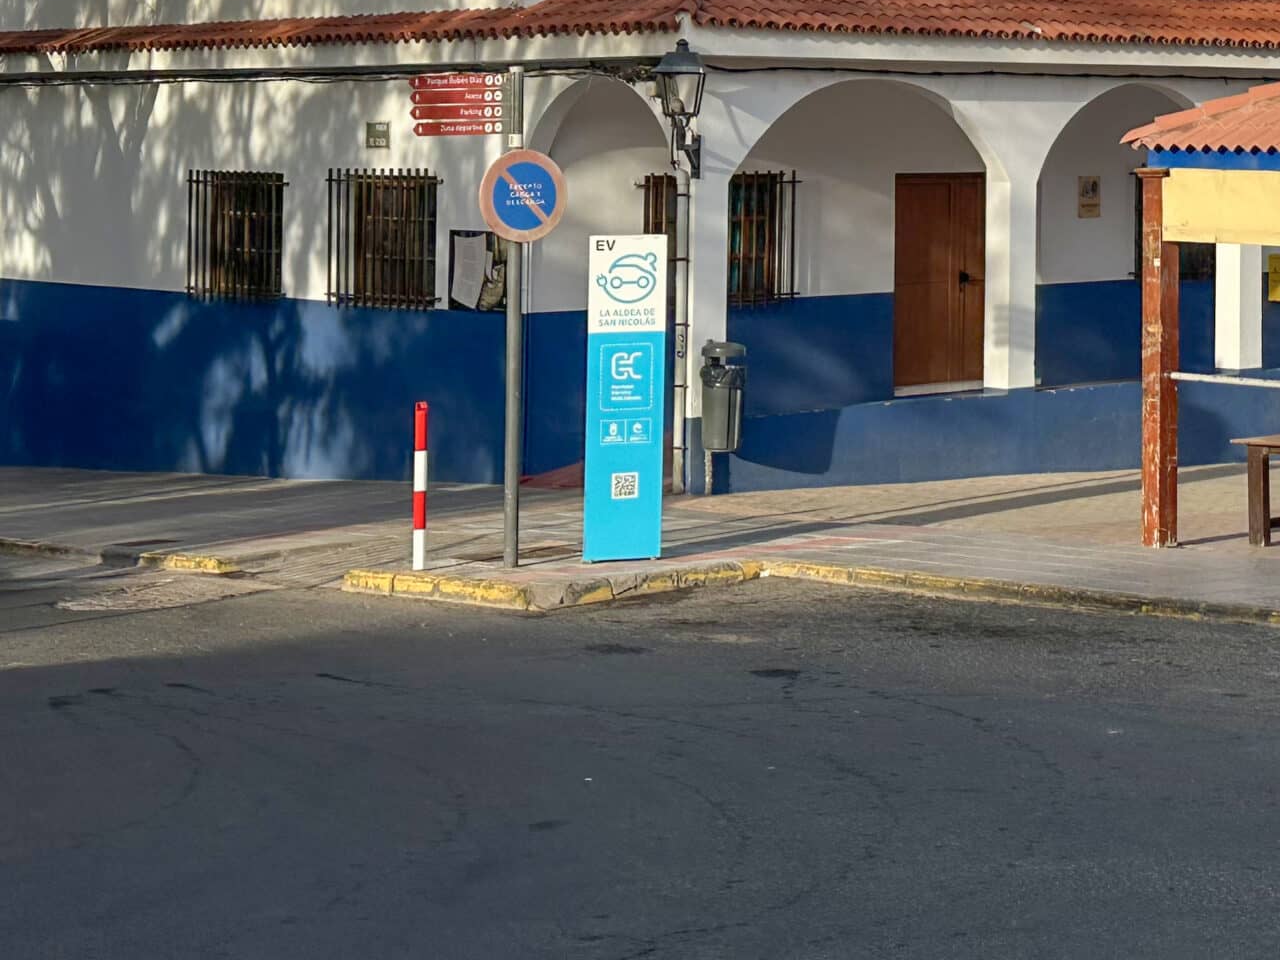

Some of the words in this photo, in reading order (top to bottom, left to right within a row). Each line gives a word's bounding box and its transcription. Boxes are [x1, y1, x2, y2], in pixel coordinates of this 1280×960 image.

[596, 240, 616, 252] EV
[599, 309, 611, 318] LA
[612, 308, 642, 317] ALDEA
[643, 307, 656, 316] DE
[598, 319, 616, 327] SAN
